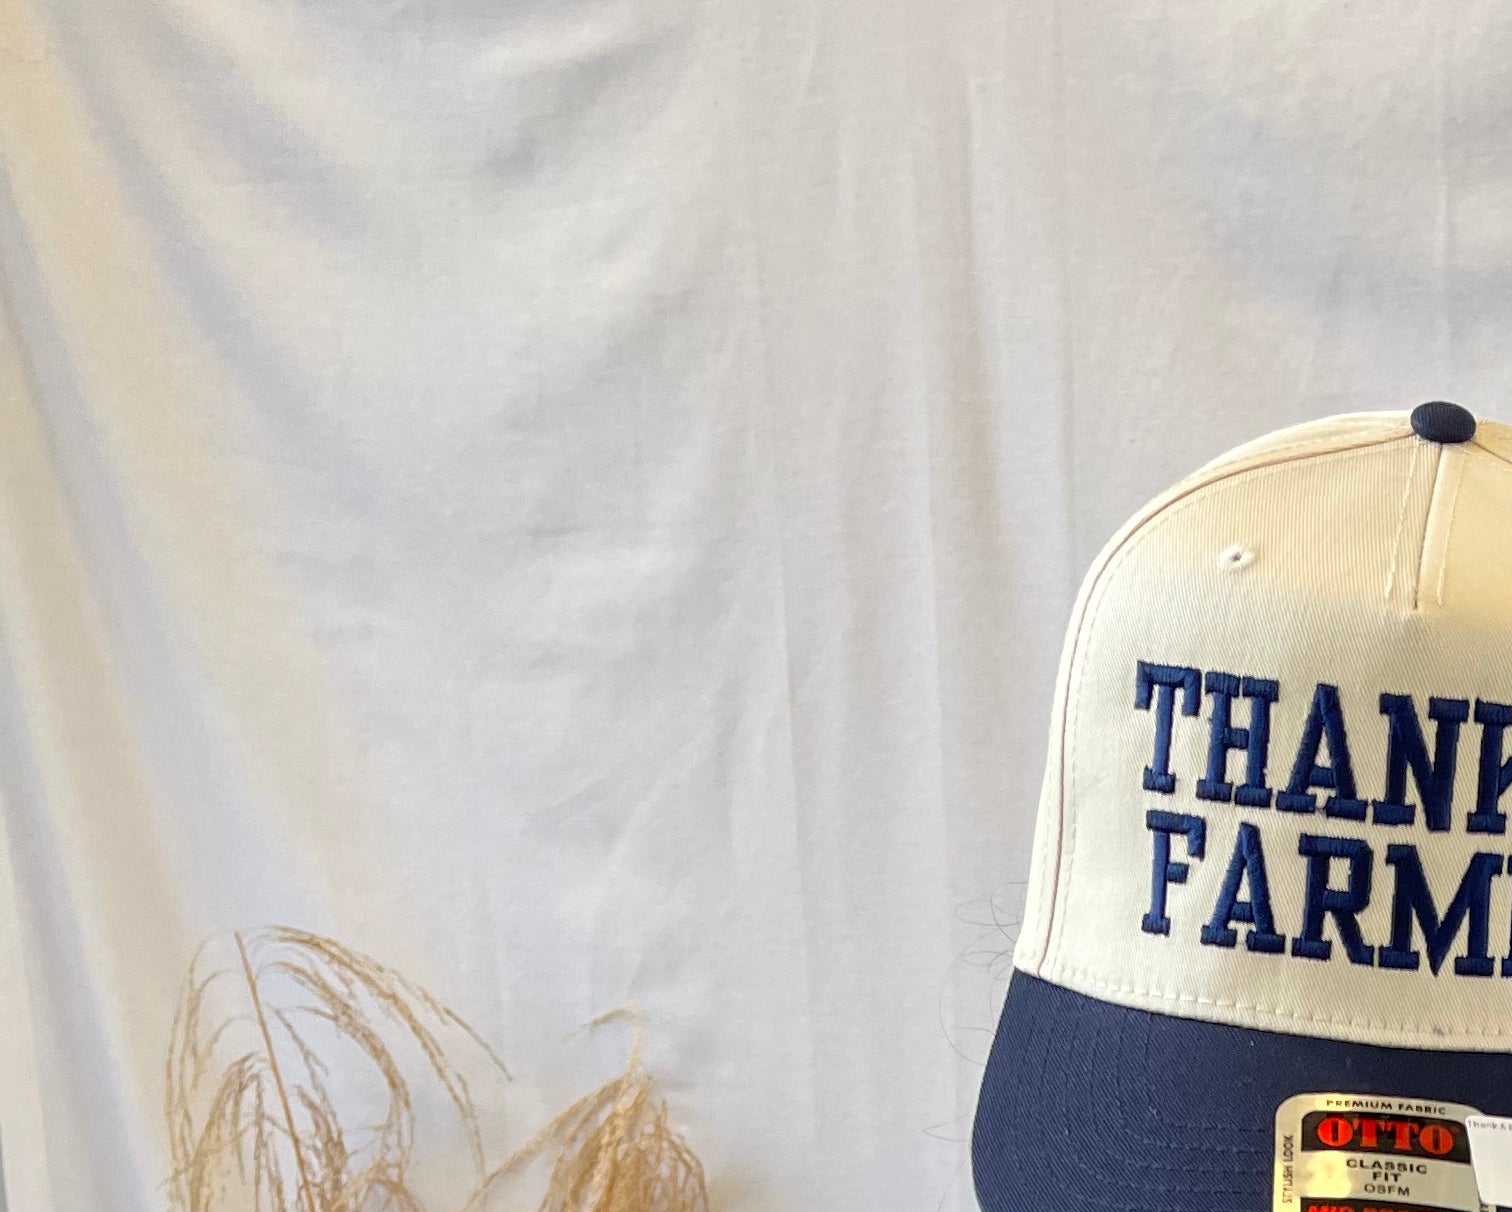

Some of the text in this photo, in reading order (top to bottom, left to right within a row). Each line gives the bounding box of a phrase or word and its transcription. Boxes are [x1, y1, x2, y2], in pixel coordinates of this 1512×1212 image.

[1326, 1100, 1447, 1116] PREMIUM FABRIC
[1316, 1117, 1454, 1156] OTTO
[1281, 1134, 1294, 1204] STYLISH LOOK
[1346, 1158, 1428, 1175] CLASSIC
[1372, 1172, 1402, 1183] FIT
[1363, 1184, 1411, 1197] OSFM
